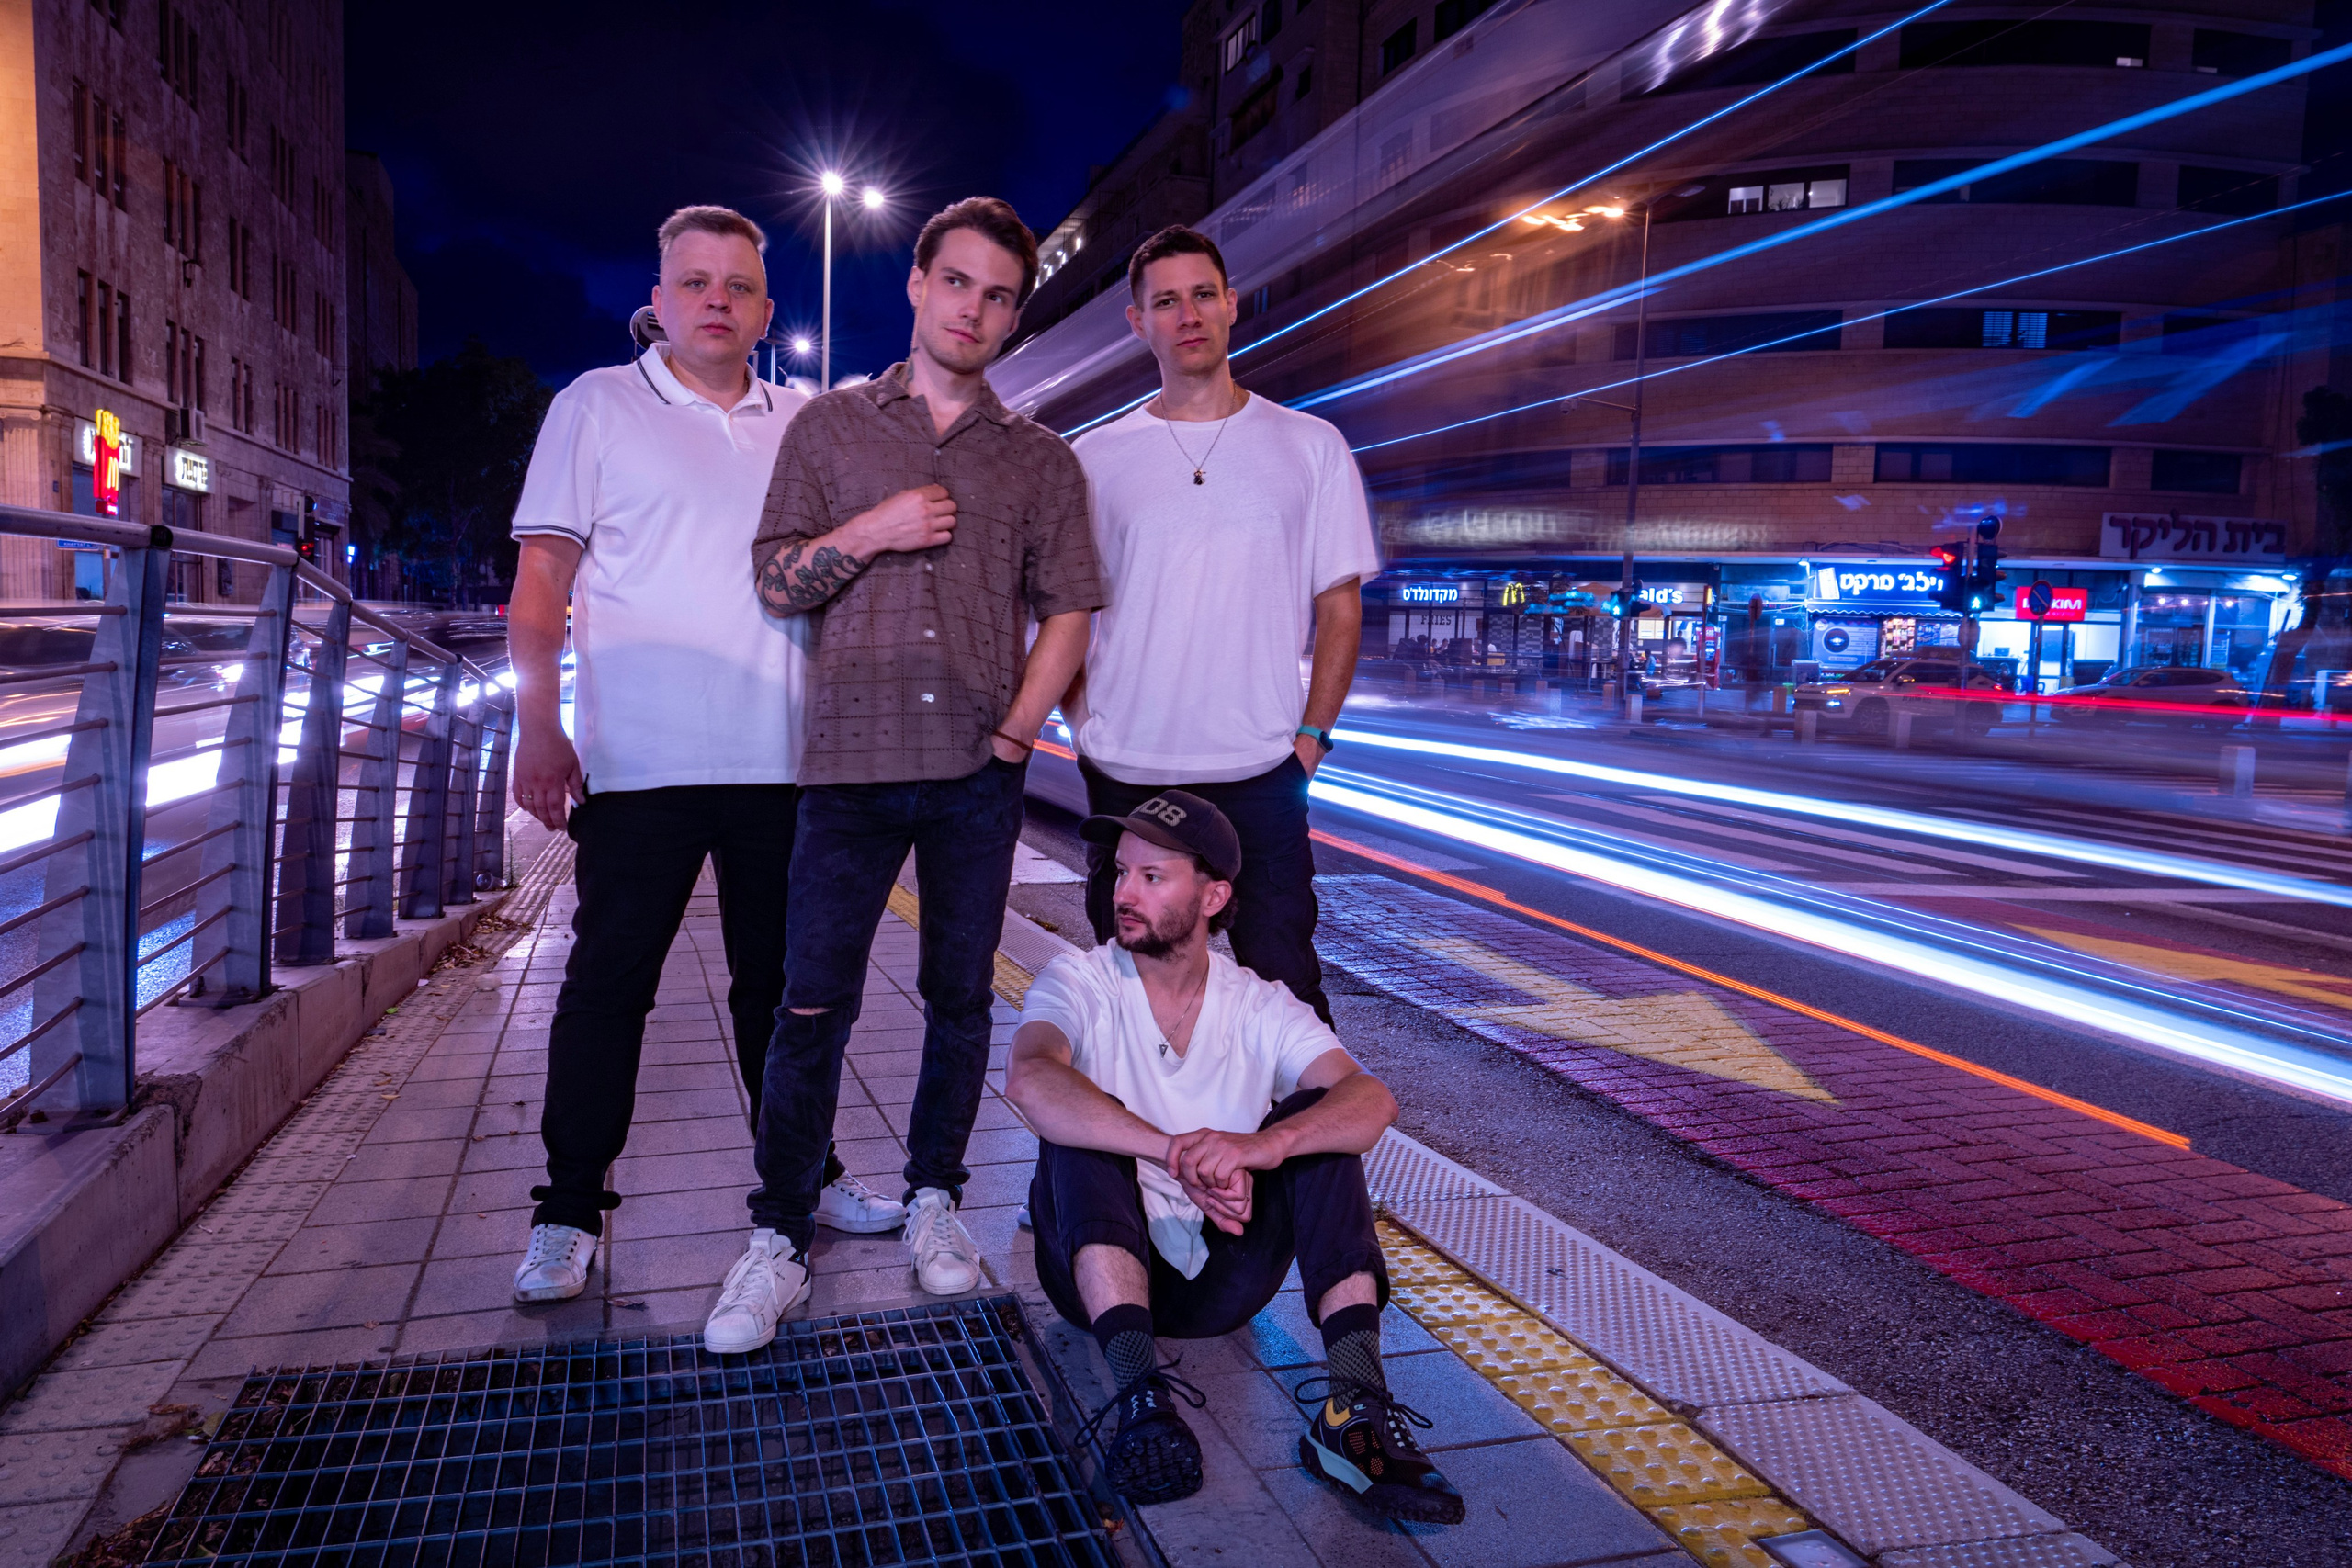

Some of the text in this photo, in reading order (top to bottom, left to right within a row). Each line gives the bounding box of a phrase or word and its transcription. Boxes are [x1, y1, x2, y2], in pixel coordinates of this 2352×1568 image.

[2109, 508, 2286, 559] בית הליקר
[1840, 573, 1894, 595] מרקט
[1403, 586, 1458, 604] מקדונלד'ס
[1639, 588, 1683, 604] ald's
